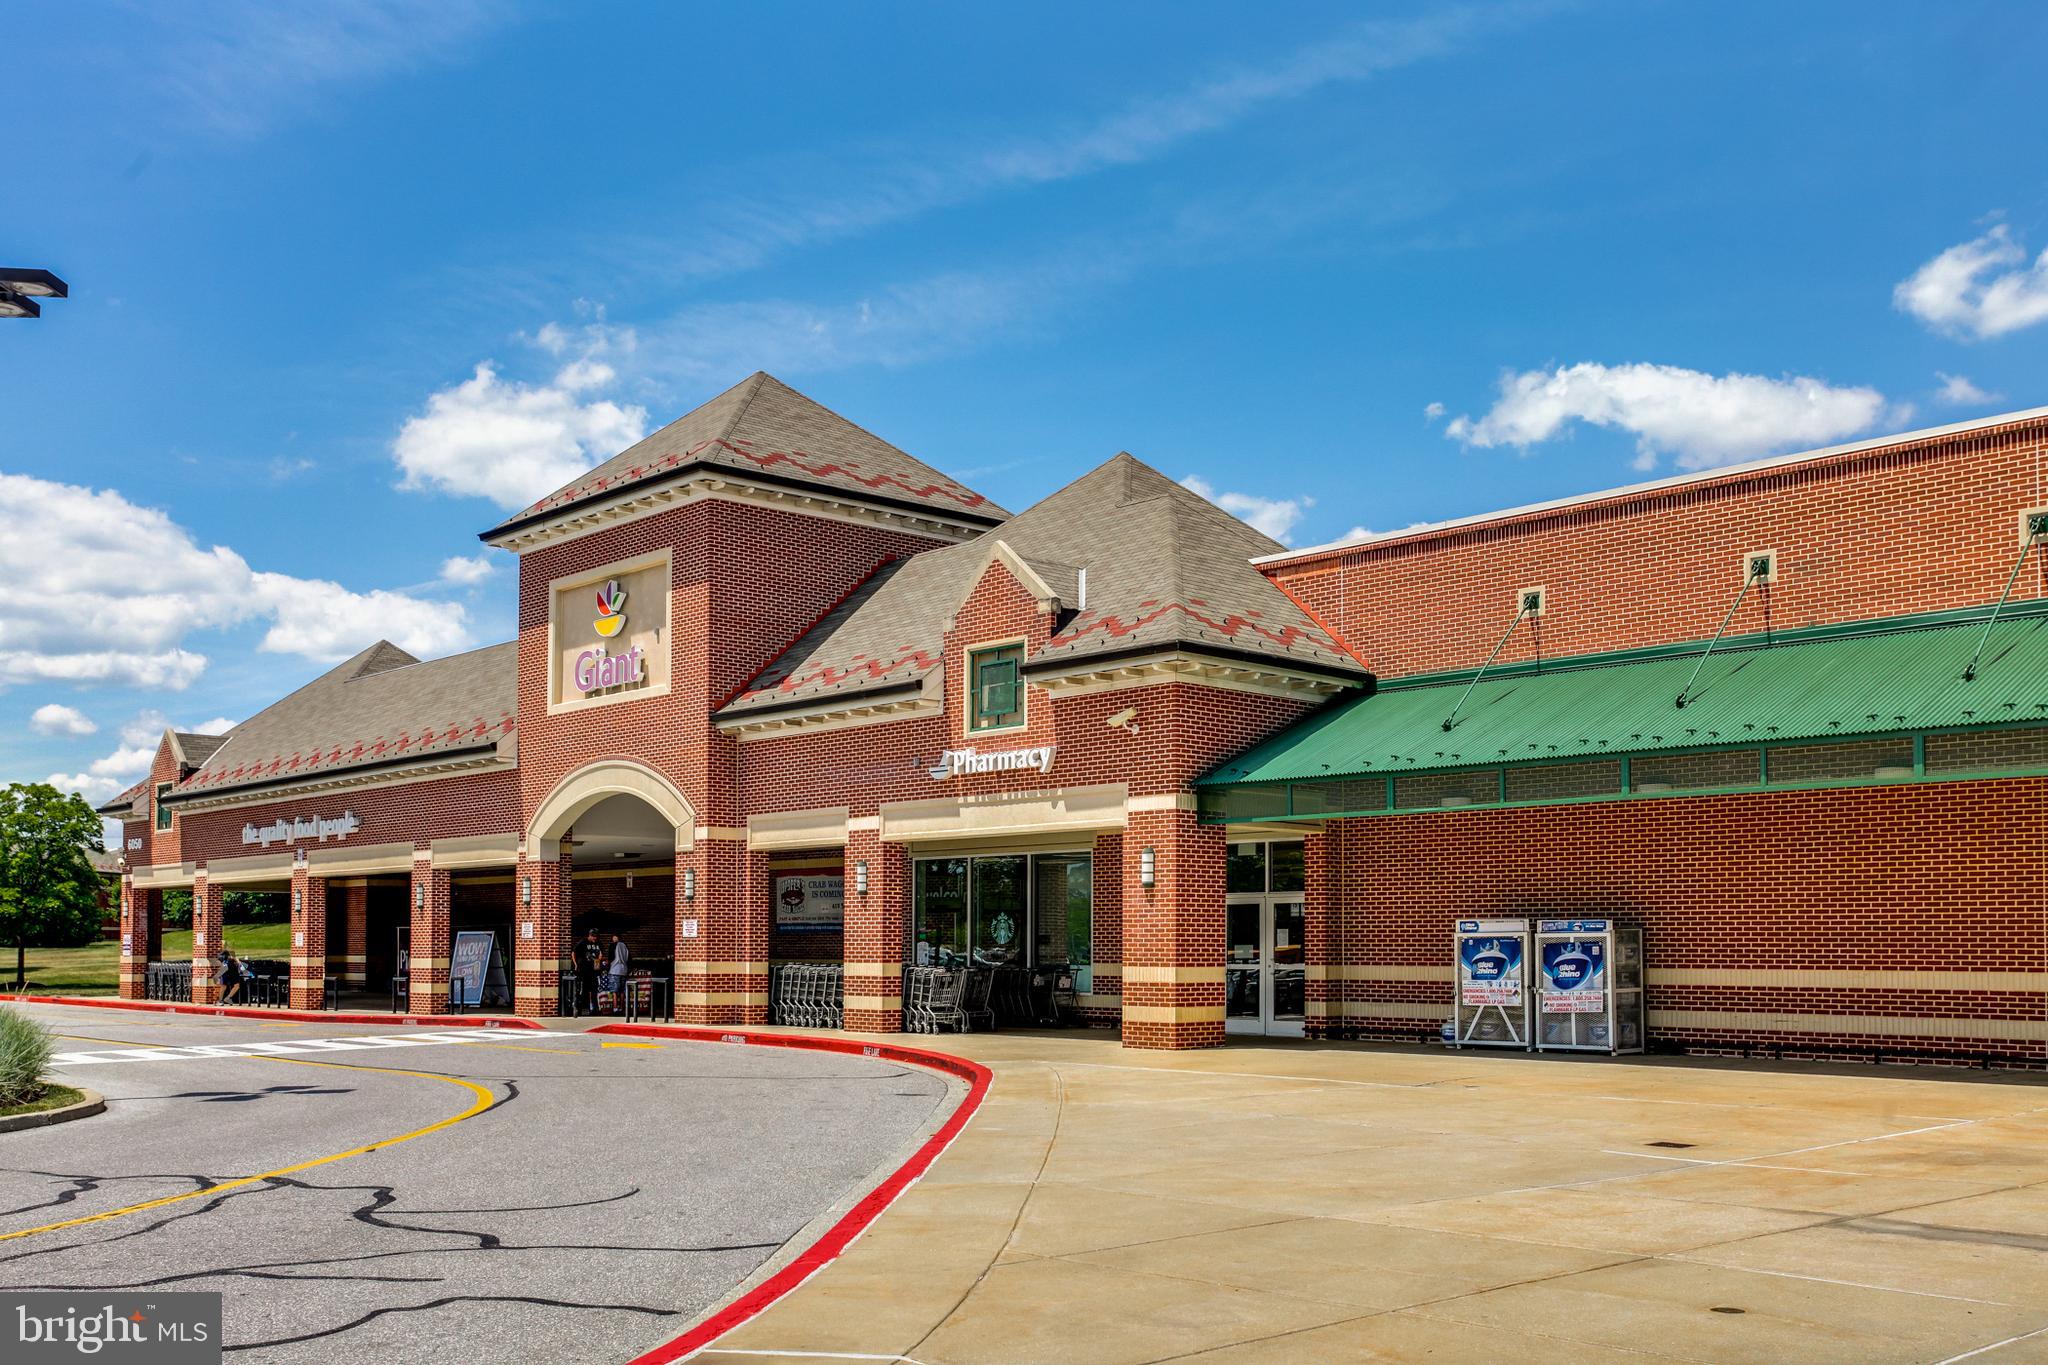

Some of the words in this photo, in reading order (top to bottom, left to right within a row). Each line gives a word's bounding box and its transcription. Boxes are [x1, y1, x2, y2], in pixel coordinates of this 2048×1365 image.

[575, 645, 642, 693] Giant
[953, 746, 1054, 775] Pharmacy
[242, 822, 260, 844] the
[260, 818, 295, 847] quality
[294, 815, 321, 839] food
[319, 811, 359, 842] people
[812, 890, 818, 898] IS
